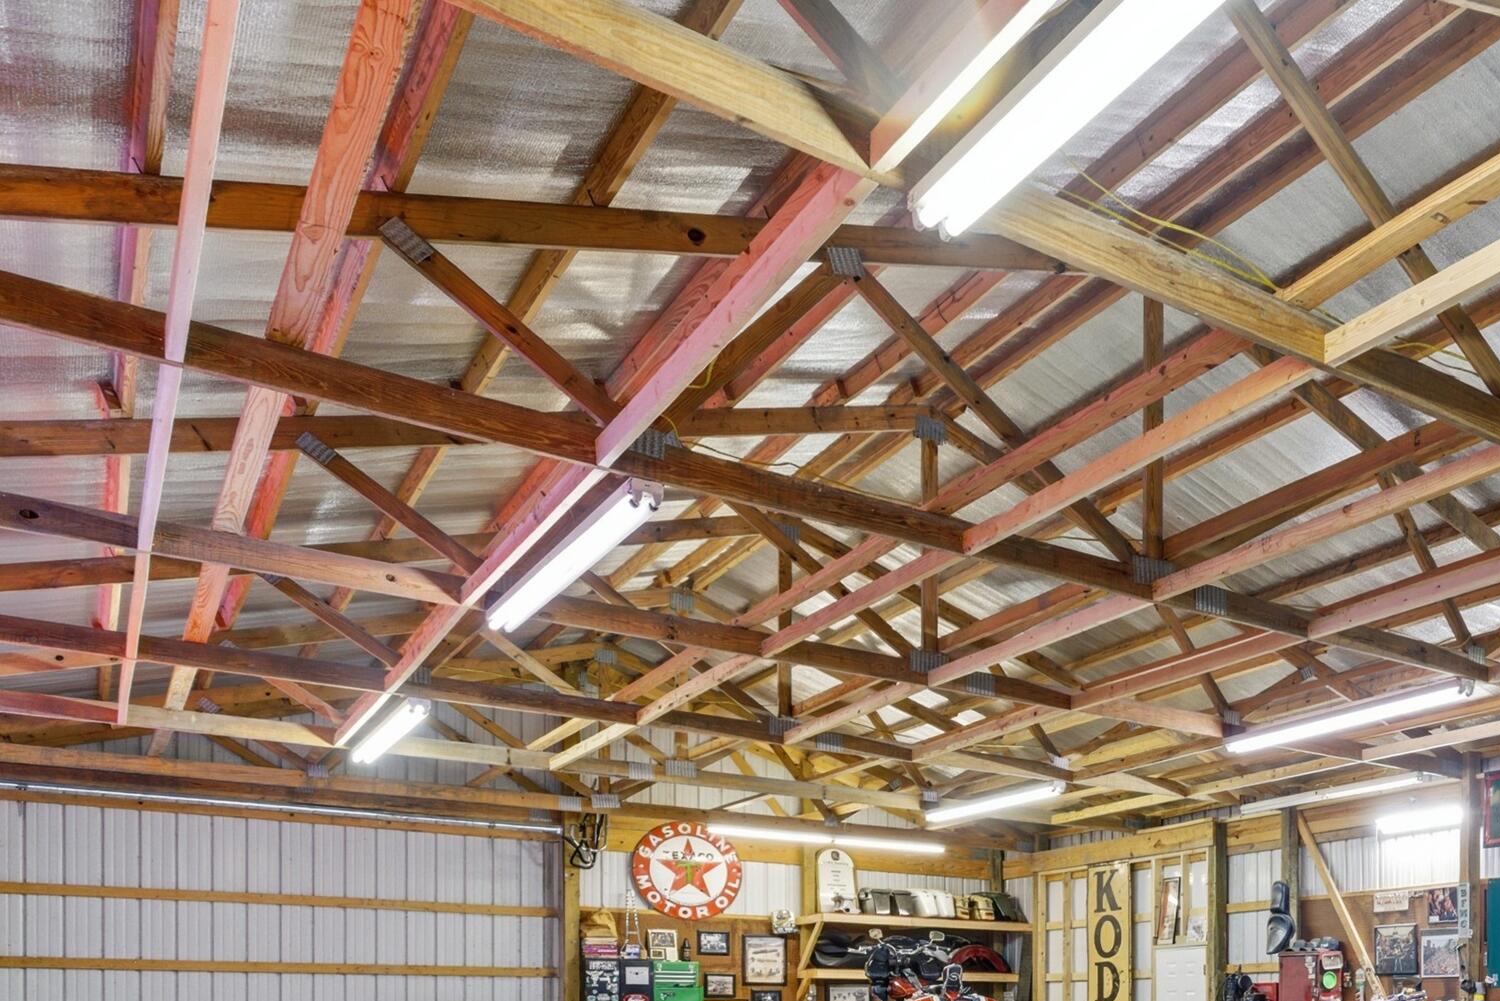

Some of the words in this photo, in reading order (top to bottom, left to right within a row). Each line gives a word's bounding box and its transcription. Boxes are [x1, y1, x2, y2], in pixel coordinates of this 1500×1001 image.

[638, 823, 739, 864] GASOLINE
[636, 875, 710, 918] MOTOR
[715, 879, 740, 908] OIL
